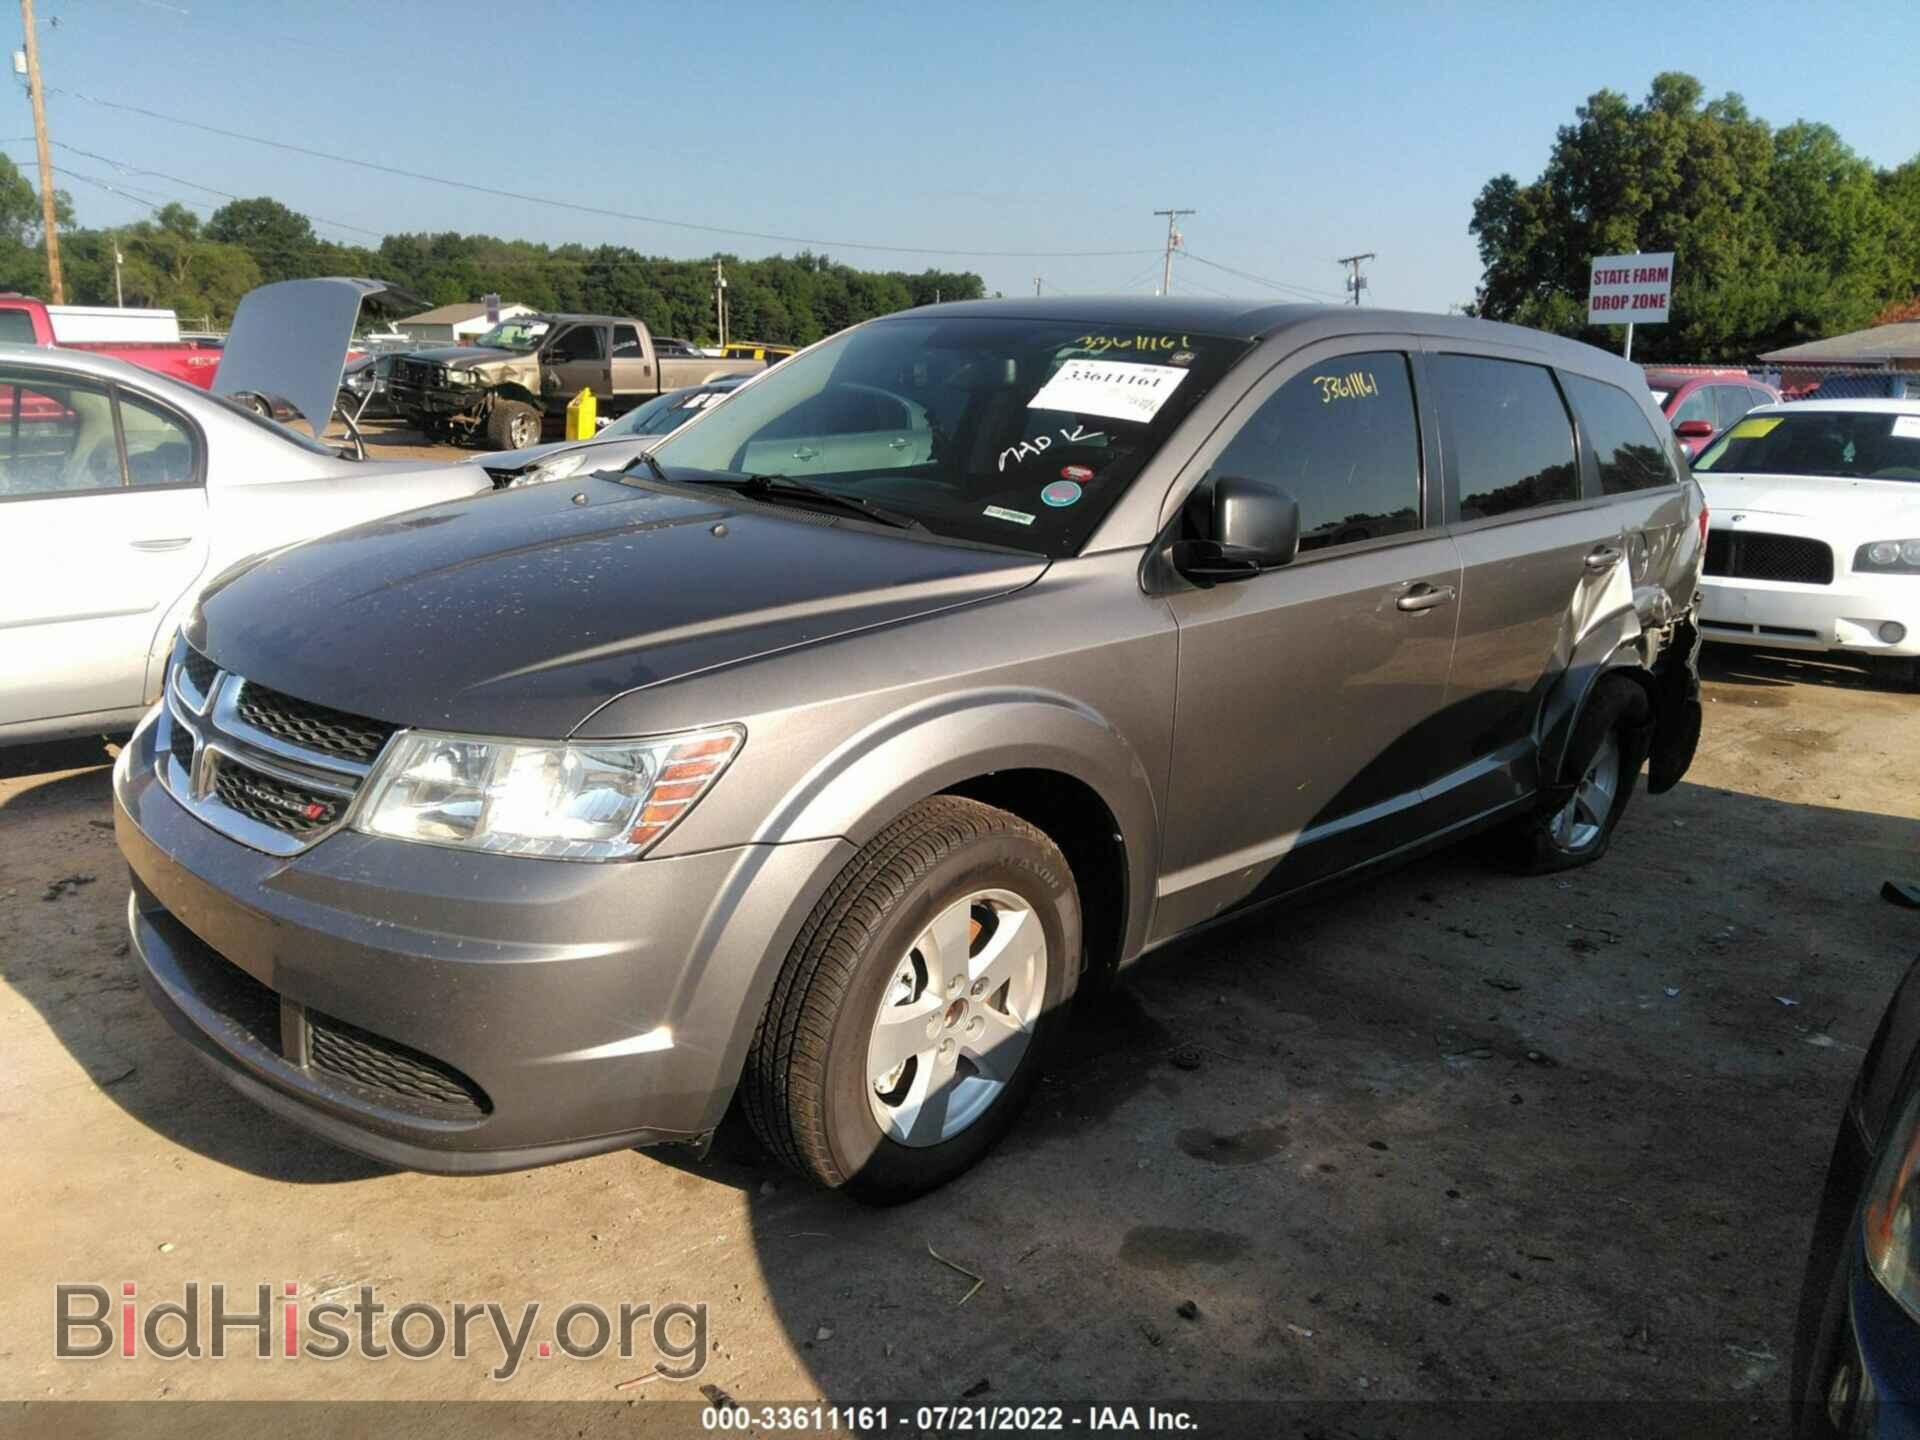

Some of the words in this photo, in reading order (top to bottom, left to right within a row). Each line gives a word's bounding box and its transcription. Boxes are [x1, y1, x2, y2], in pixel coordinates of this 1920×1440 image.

[1594, 269, 1630, 285] STATE
[1633, 267, 1669, 283] FARM
[1592, 294, 1629, 311] DROP
[1631, 293, 1666, 309] ZONE
[1065, 370, 1161, 388] 33611161
[1313, 371, 1379, 403] 33611161
